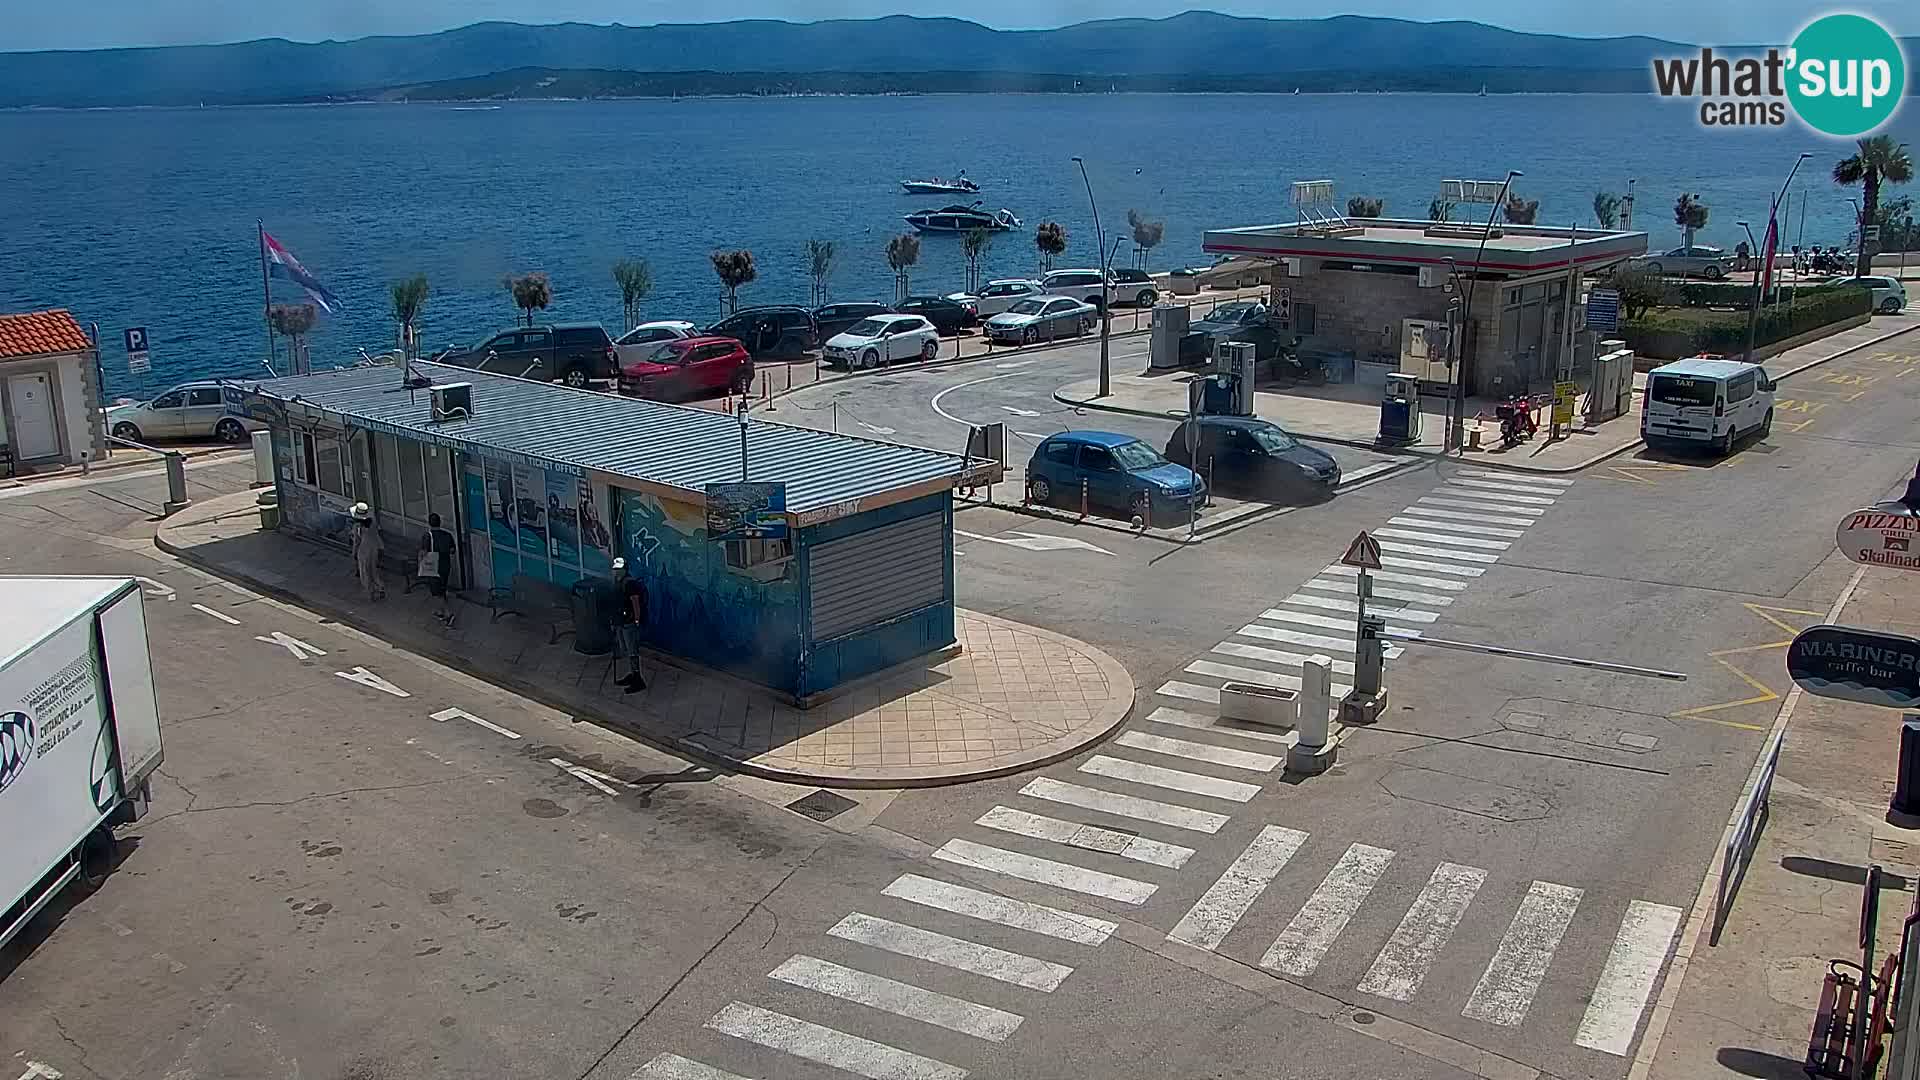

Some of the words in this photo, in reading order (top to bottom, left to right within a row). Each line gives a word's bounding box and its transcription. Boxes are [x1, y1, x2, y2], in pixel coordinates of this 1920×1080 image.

[1674, 379, 1695, 388] TAXI
[436, 438, 466, 452] POSTAJA
[496, 449, 528, 465] STATION
[529, 456, 554, 471] TICKET
[555, 462, 583, 477] OFFICE
[1848, 514, 1920, 533] PIZZE
[1826, 661, 1866, 673] caffe
[1869, 665, 1897, 679] bar
